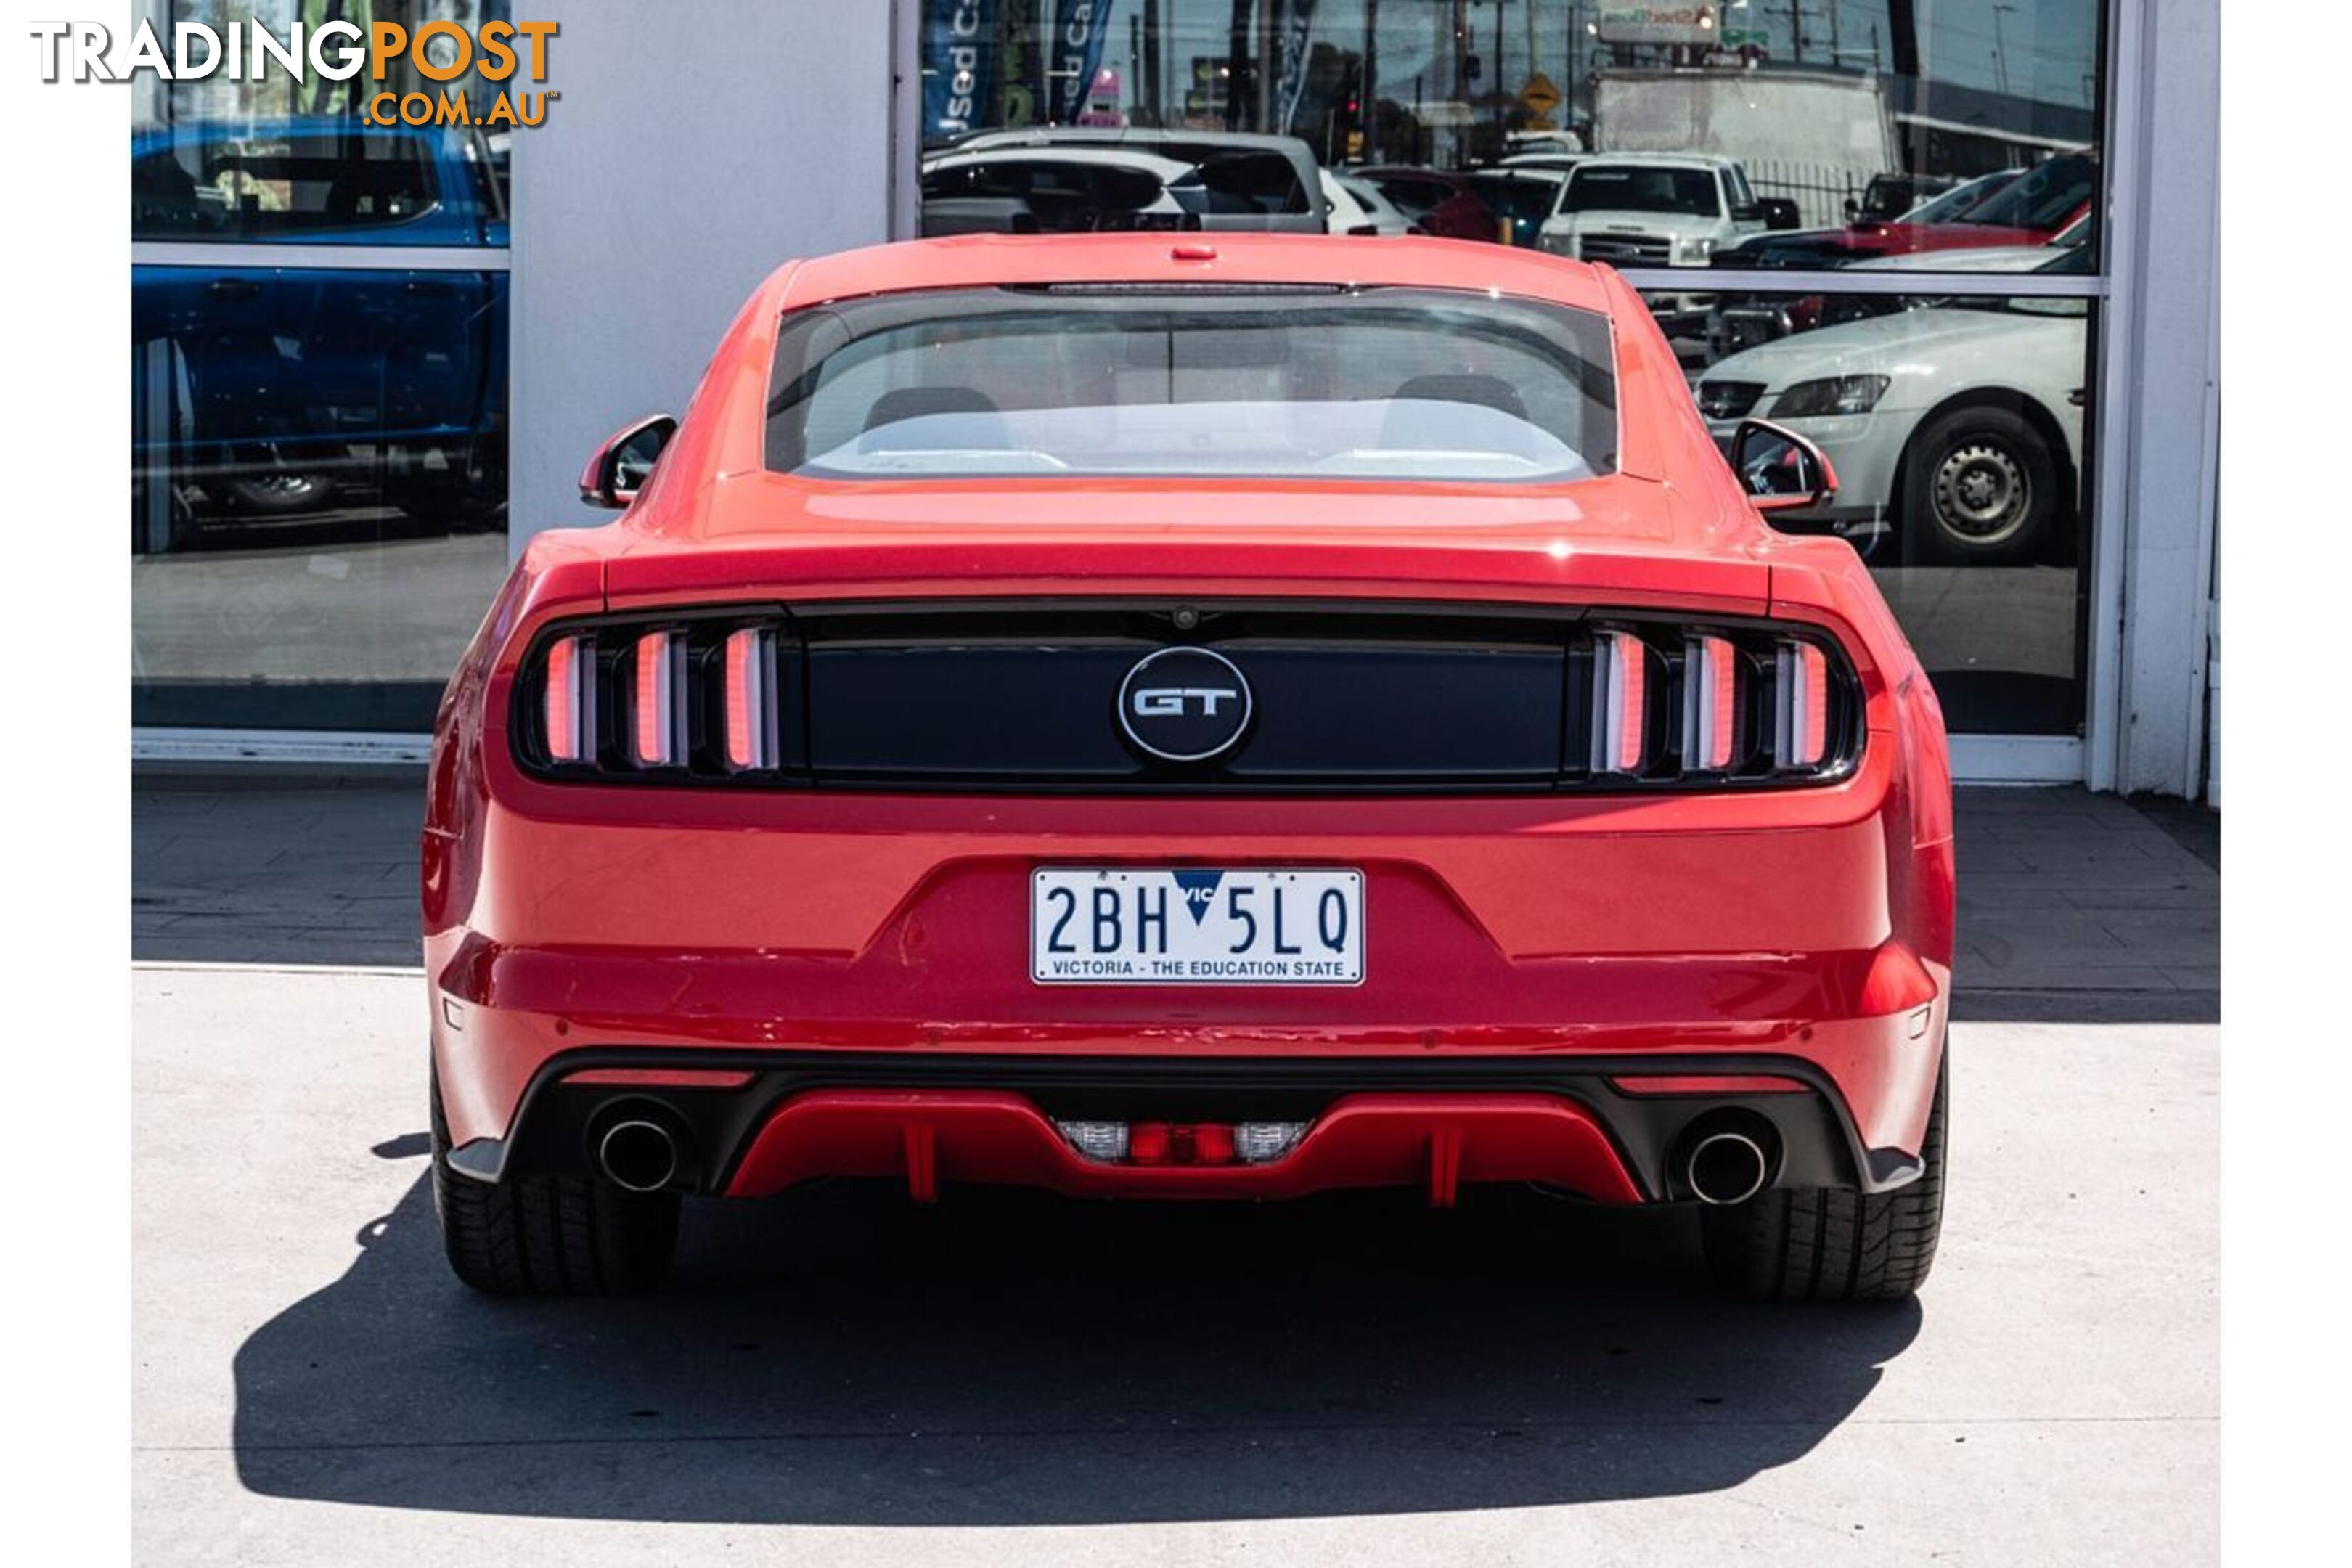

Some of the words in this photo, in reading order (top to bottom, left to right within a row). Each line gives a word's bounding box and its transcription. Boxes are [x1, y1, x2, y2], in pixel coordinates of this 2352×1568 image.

[952, 0, 979, 36] C
[1066, 1, 1093, 46] Ca
[1134, 688, 1238, 716] GT
[1177, 887, 1215, 902] VIC
[1046, 886, 1167, 953] 2BH
[1229, 886, 1348, 954] 5LQ
[1053, 960, 1133, 975] VICTORIA
[1151, 961, 1184, 976] THE
[1190, 961, 1288, 976] EDUCATION
[1293, 962, 1344, 976] STATE
